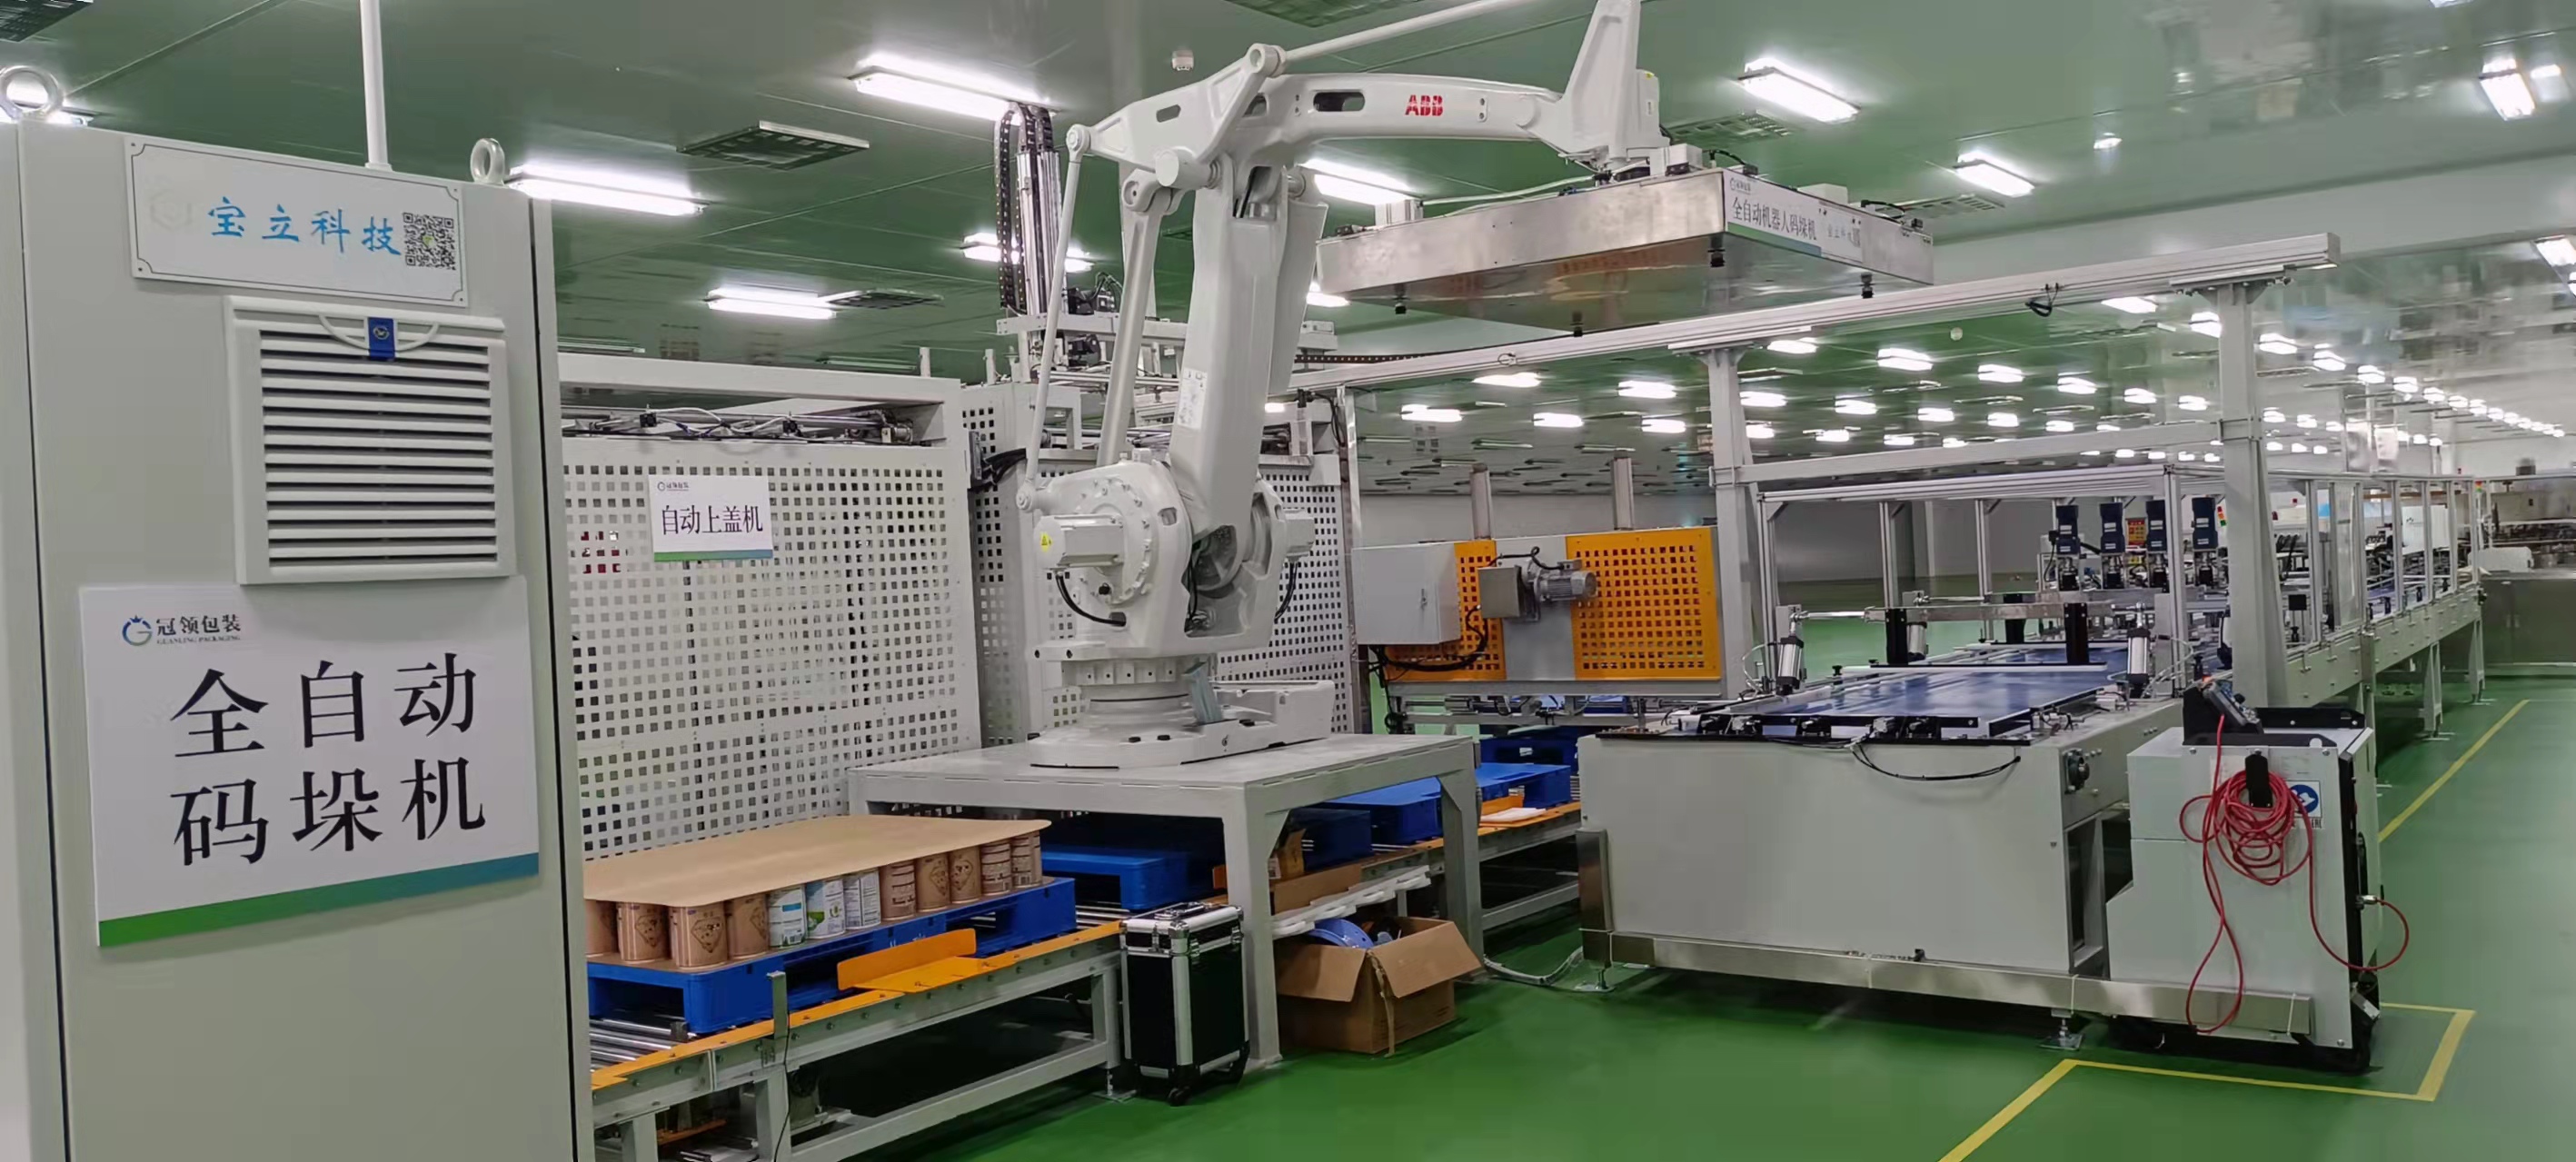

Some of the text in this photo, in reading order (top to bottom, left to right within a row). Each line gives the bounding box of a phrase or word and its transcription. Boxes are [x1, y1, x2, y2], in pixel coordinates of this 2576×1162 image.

[1405, 94, 1443, 116] ABB
[207, 196, 402, 256] 宝立科技
[1732, 197, 1817, 241] 全自动机器人码垛机
[661, 504, 763, 535] 自动上盖机
[156, 614, 241, 636] 冠领包装
[170, 652, 477, 758] 全自动
[170, 757, 486, 866] 码垛机
